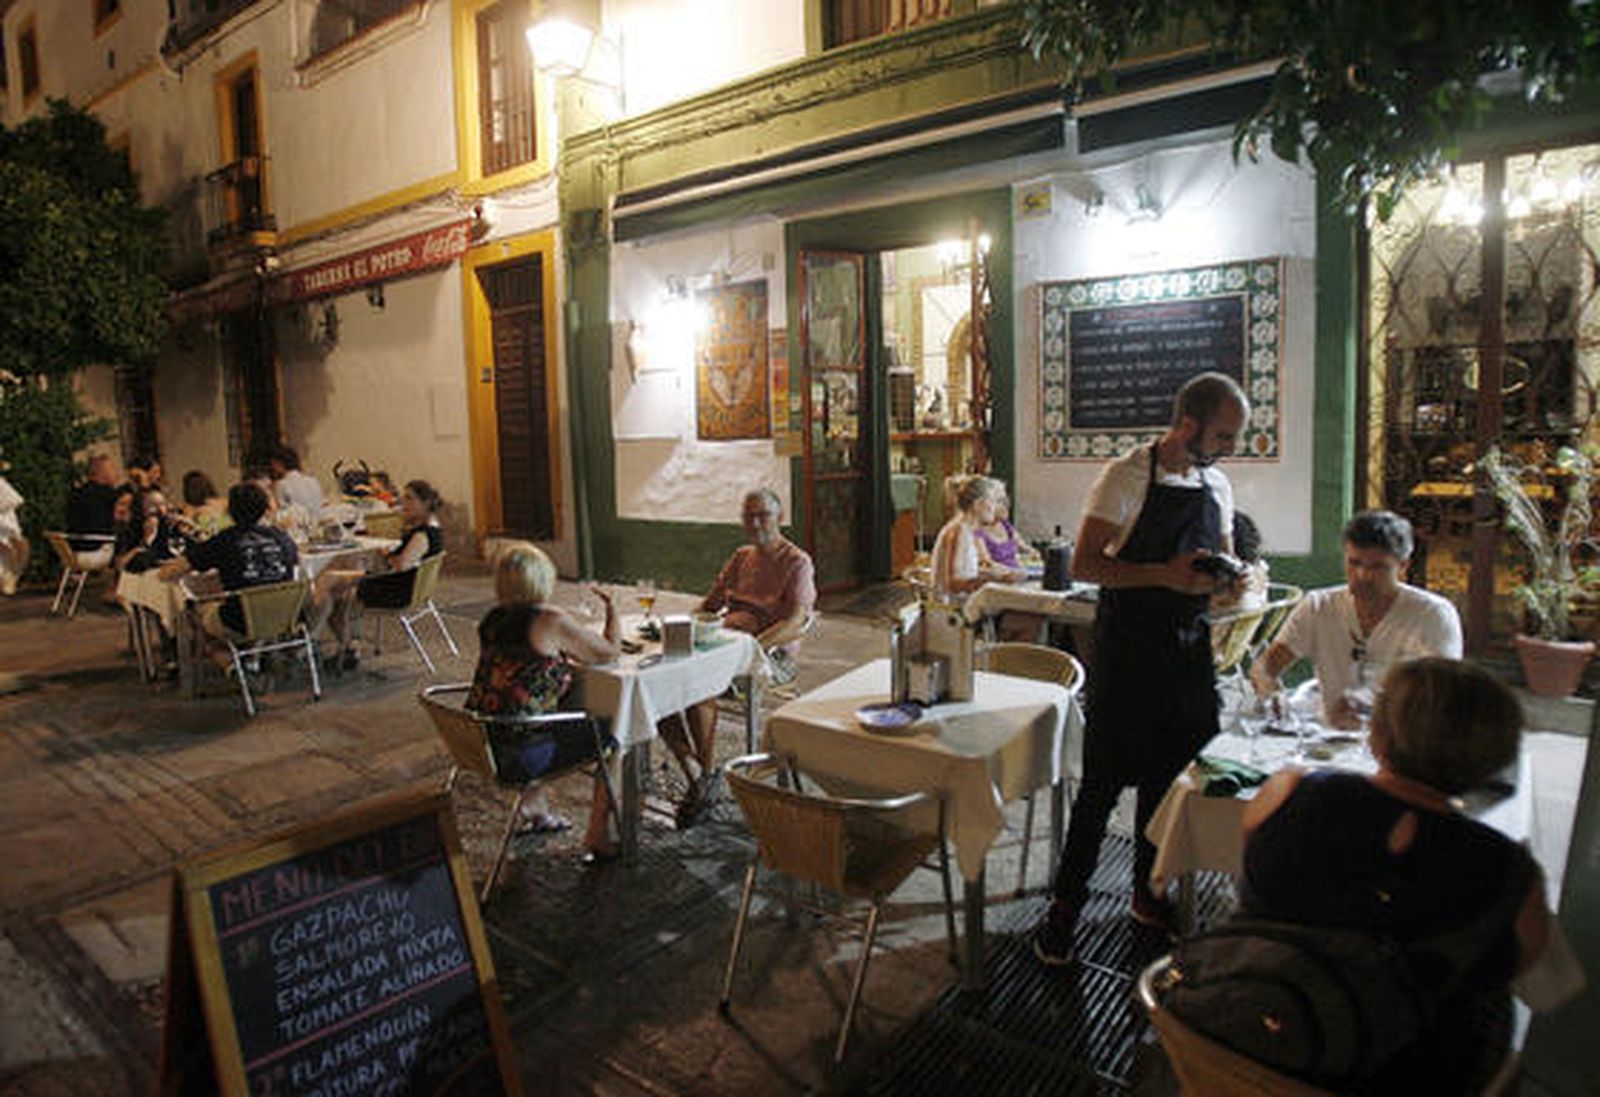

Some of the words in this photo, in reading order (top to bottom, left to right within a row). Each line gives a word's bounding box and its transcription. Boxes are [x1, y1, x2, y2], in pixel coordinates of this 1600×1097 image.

[353, 259, 368, 278] EL
[274, 912, 415, 984] SALMOREJO
[277, 951, 389, 1012] ENSALADA
[279, 984, 367, 1040] TOMATE
